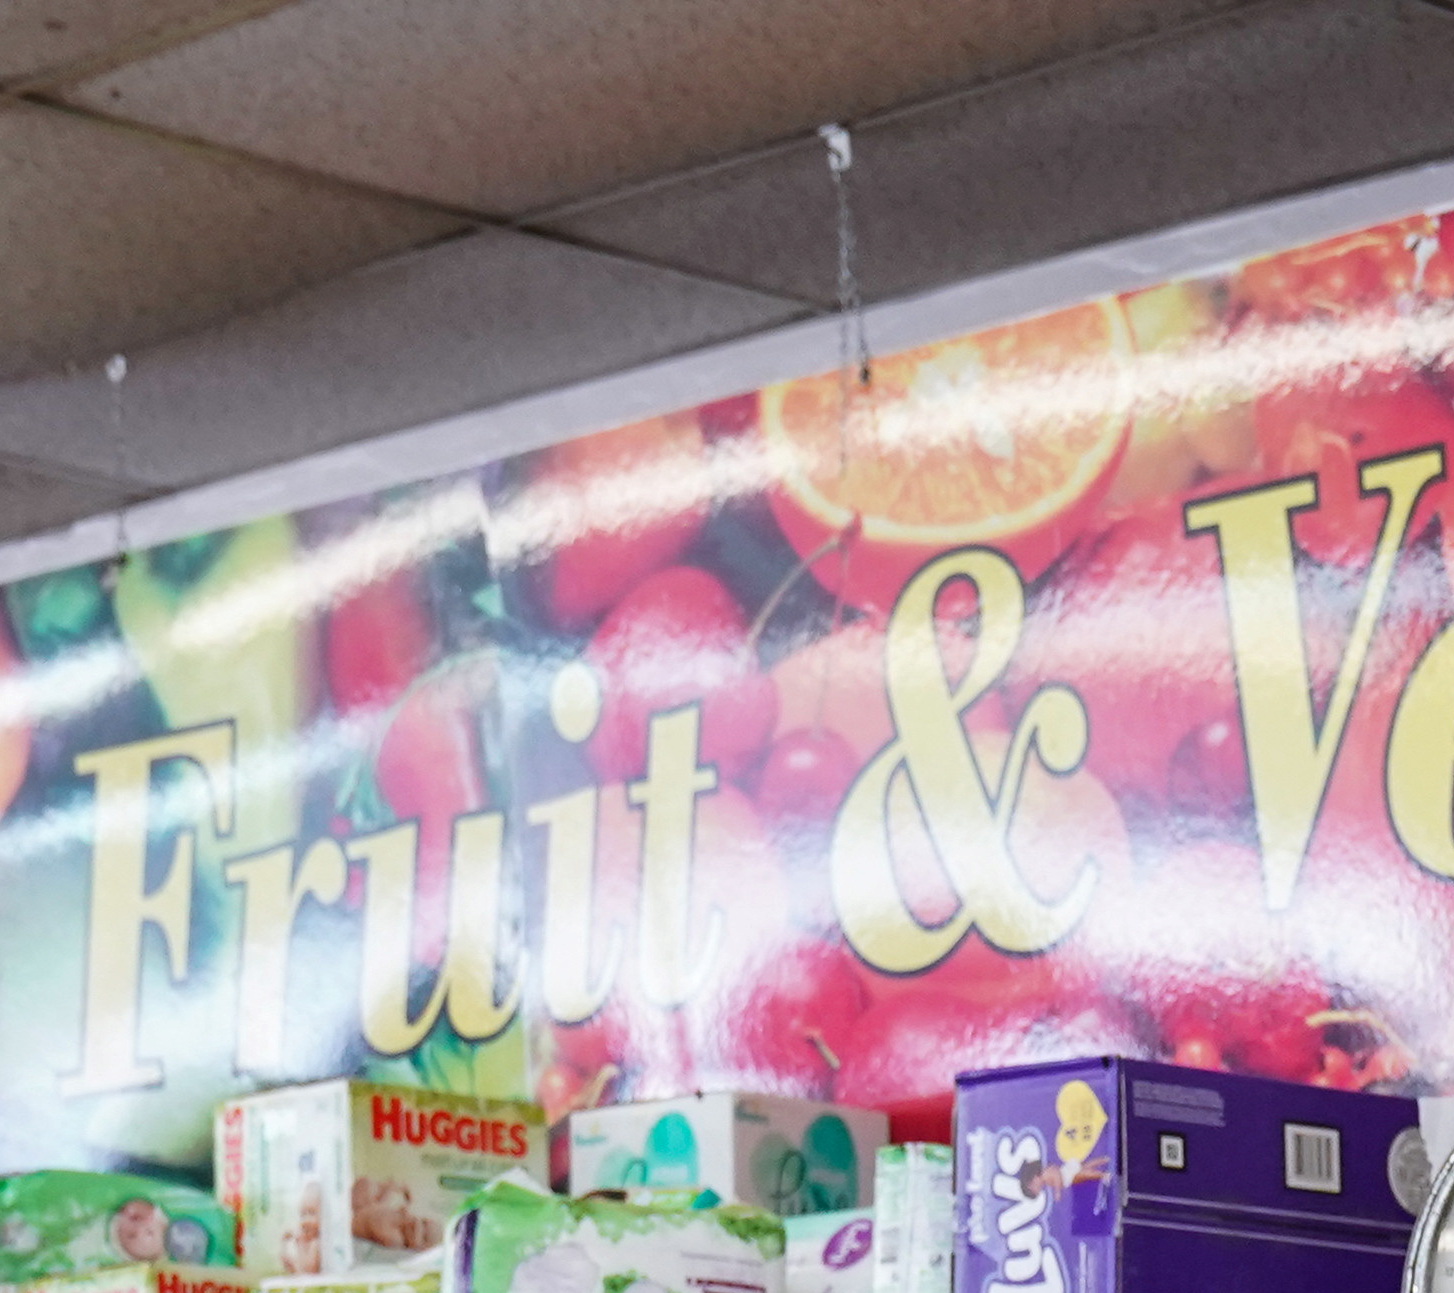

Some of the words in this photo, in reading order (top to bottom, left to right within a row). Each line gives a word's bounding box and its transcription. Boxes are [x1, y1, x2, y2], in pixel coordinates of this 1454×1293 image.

[58, 660, 724, 1102] Fruit
[831, 543, 1101, 976] &
[369, 1093, 529, 1158] HUGGIES
